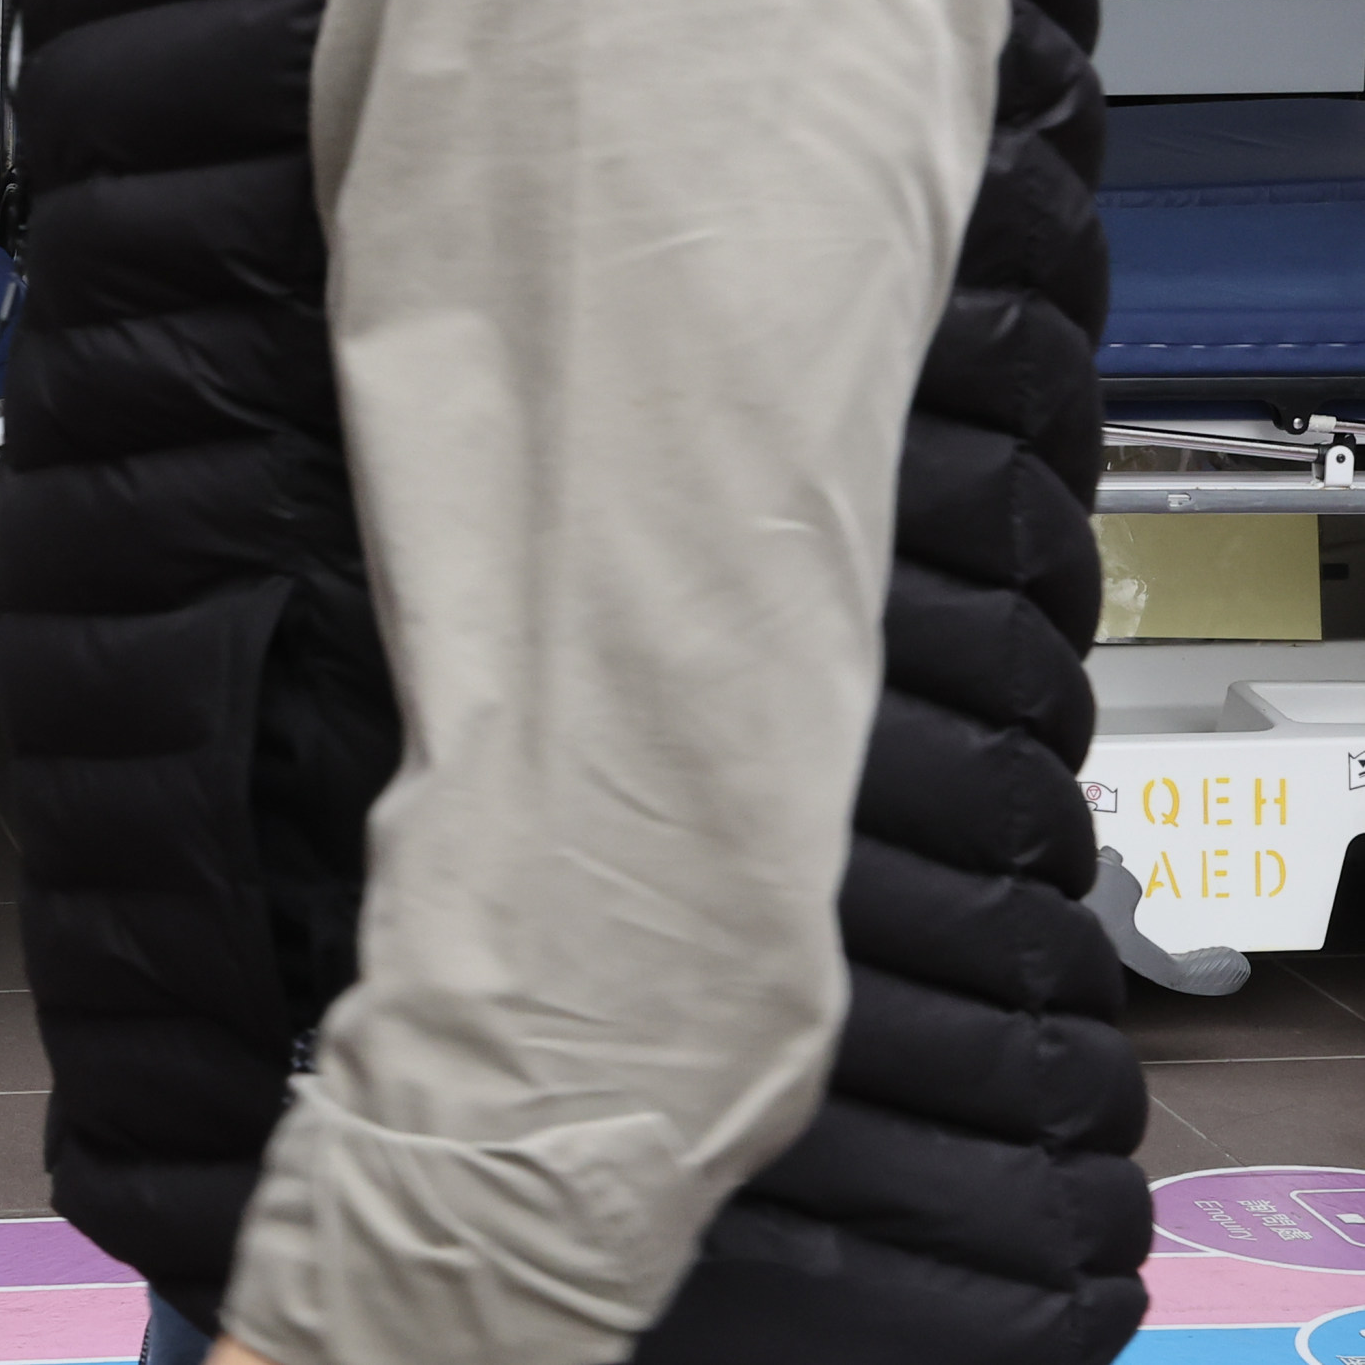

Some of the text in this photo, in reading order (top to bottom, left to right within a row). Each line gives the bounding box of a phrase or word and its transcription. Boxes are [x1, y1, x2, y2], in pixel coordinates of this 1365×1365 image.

[1142, 777, 1287, 828] QEH
[1144, 849, 1287, 899] AED
[1194, 1200, 1258, 1242] Enquiry
